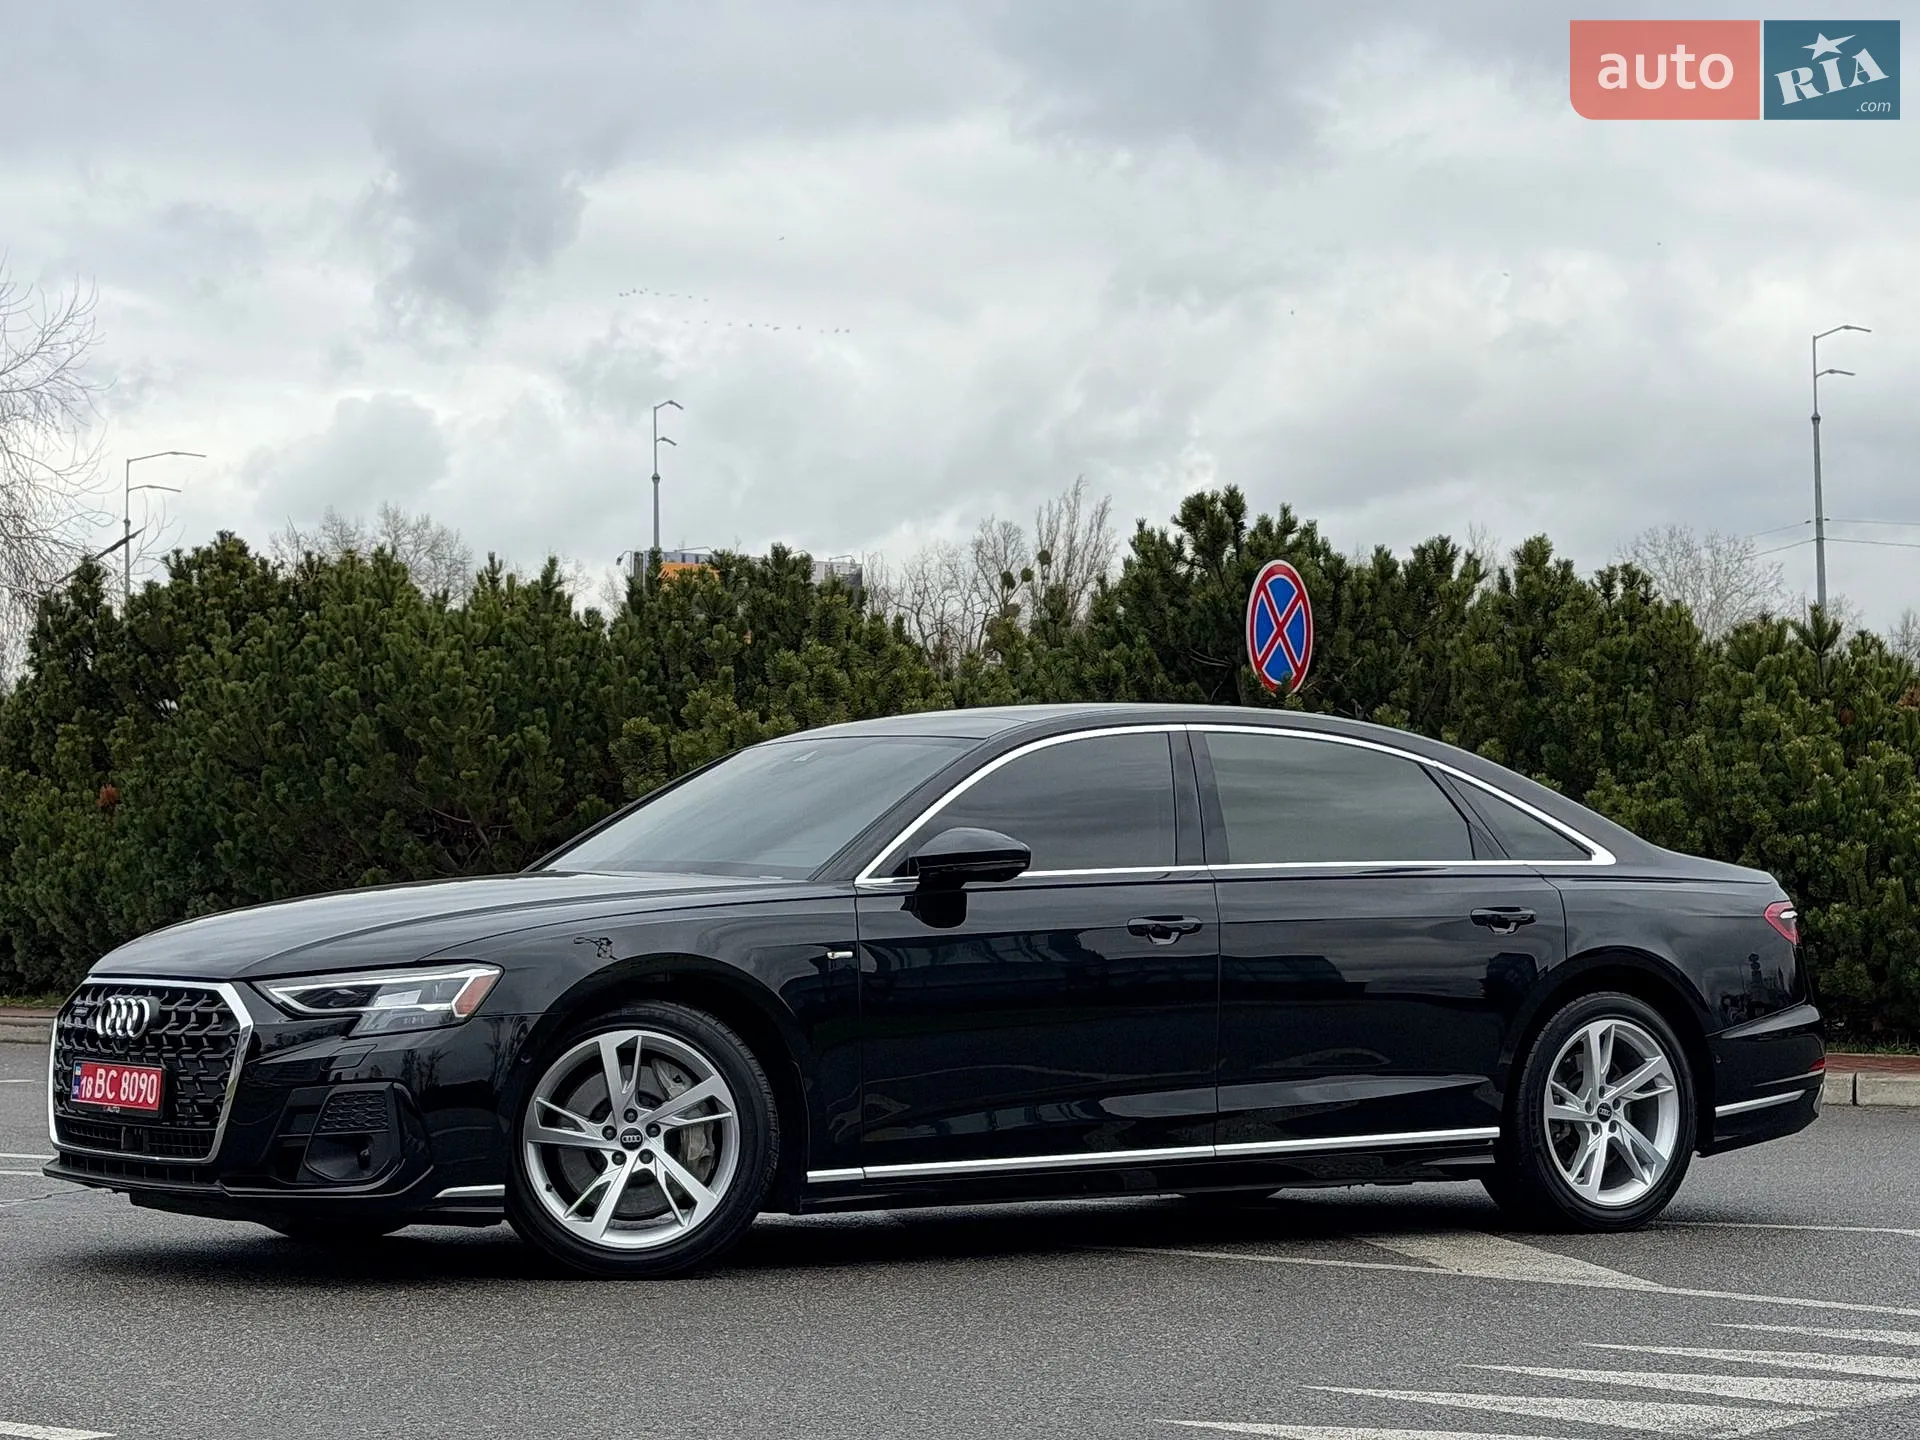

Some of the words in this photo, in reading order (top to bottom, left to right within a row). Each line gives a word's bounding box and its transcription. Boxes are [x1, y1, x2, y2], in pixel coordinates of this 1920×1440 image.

[81, 1076, 93, 1098] 18
[94, 1068, 118, 1099] BC
[120, 1071, 157, 1104] 8090
